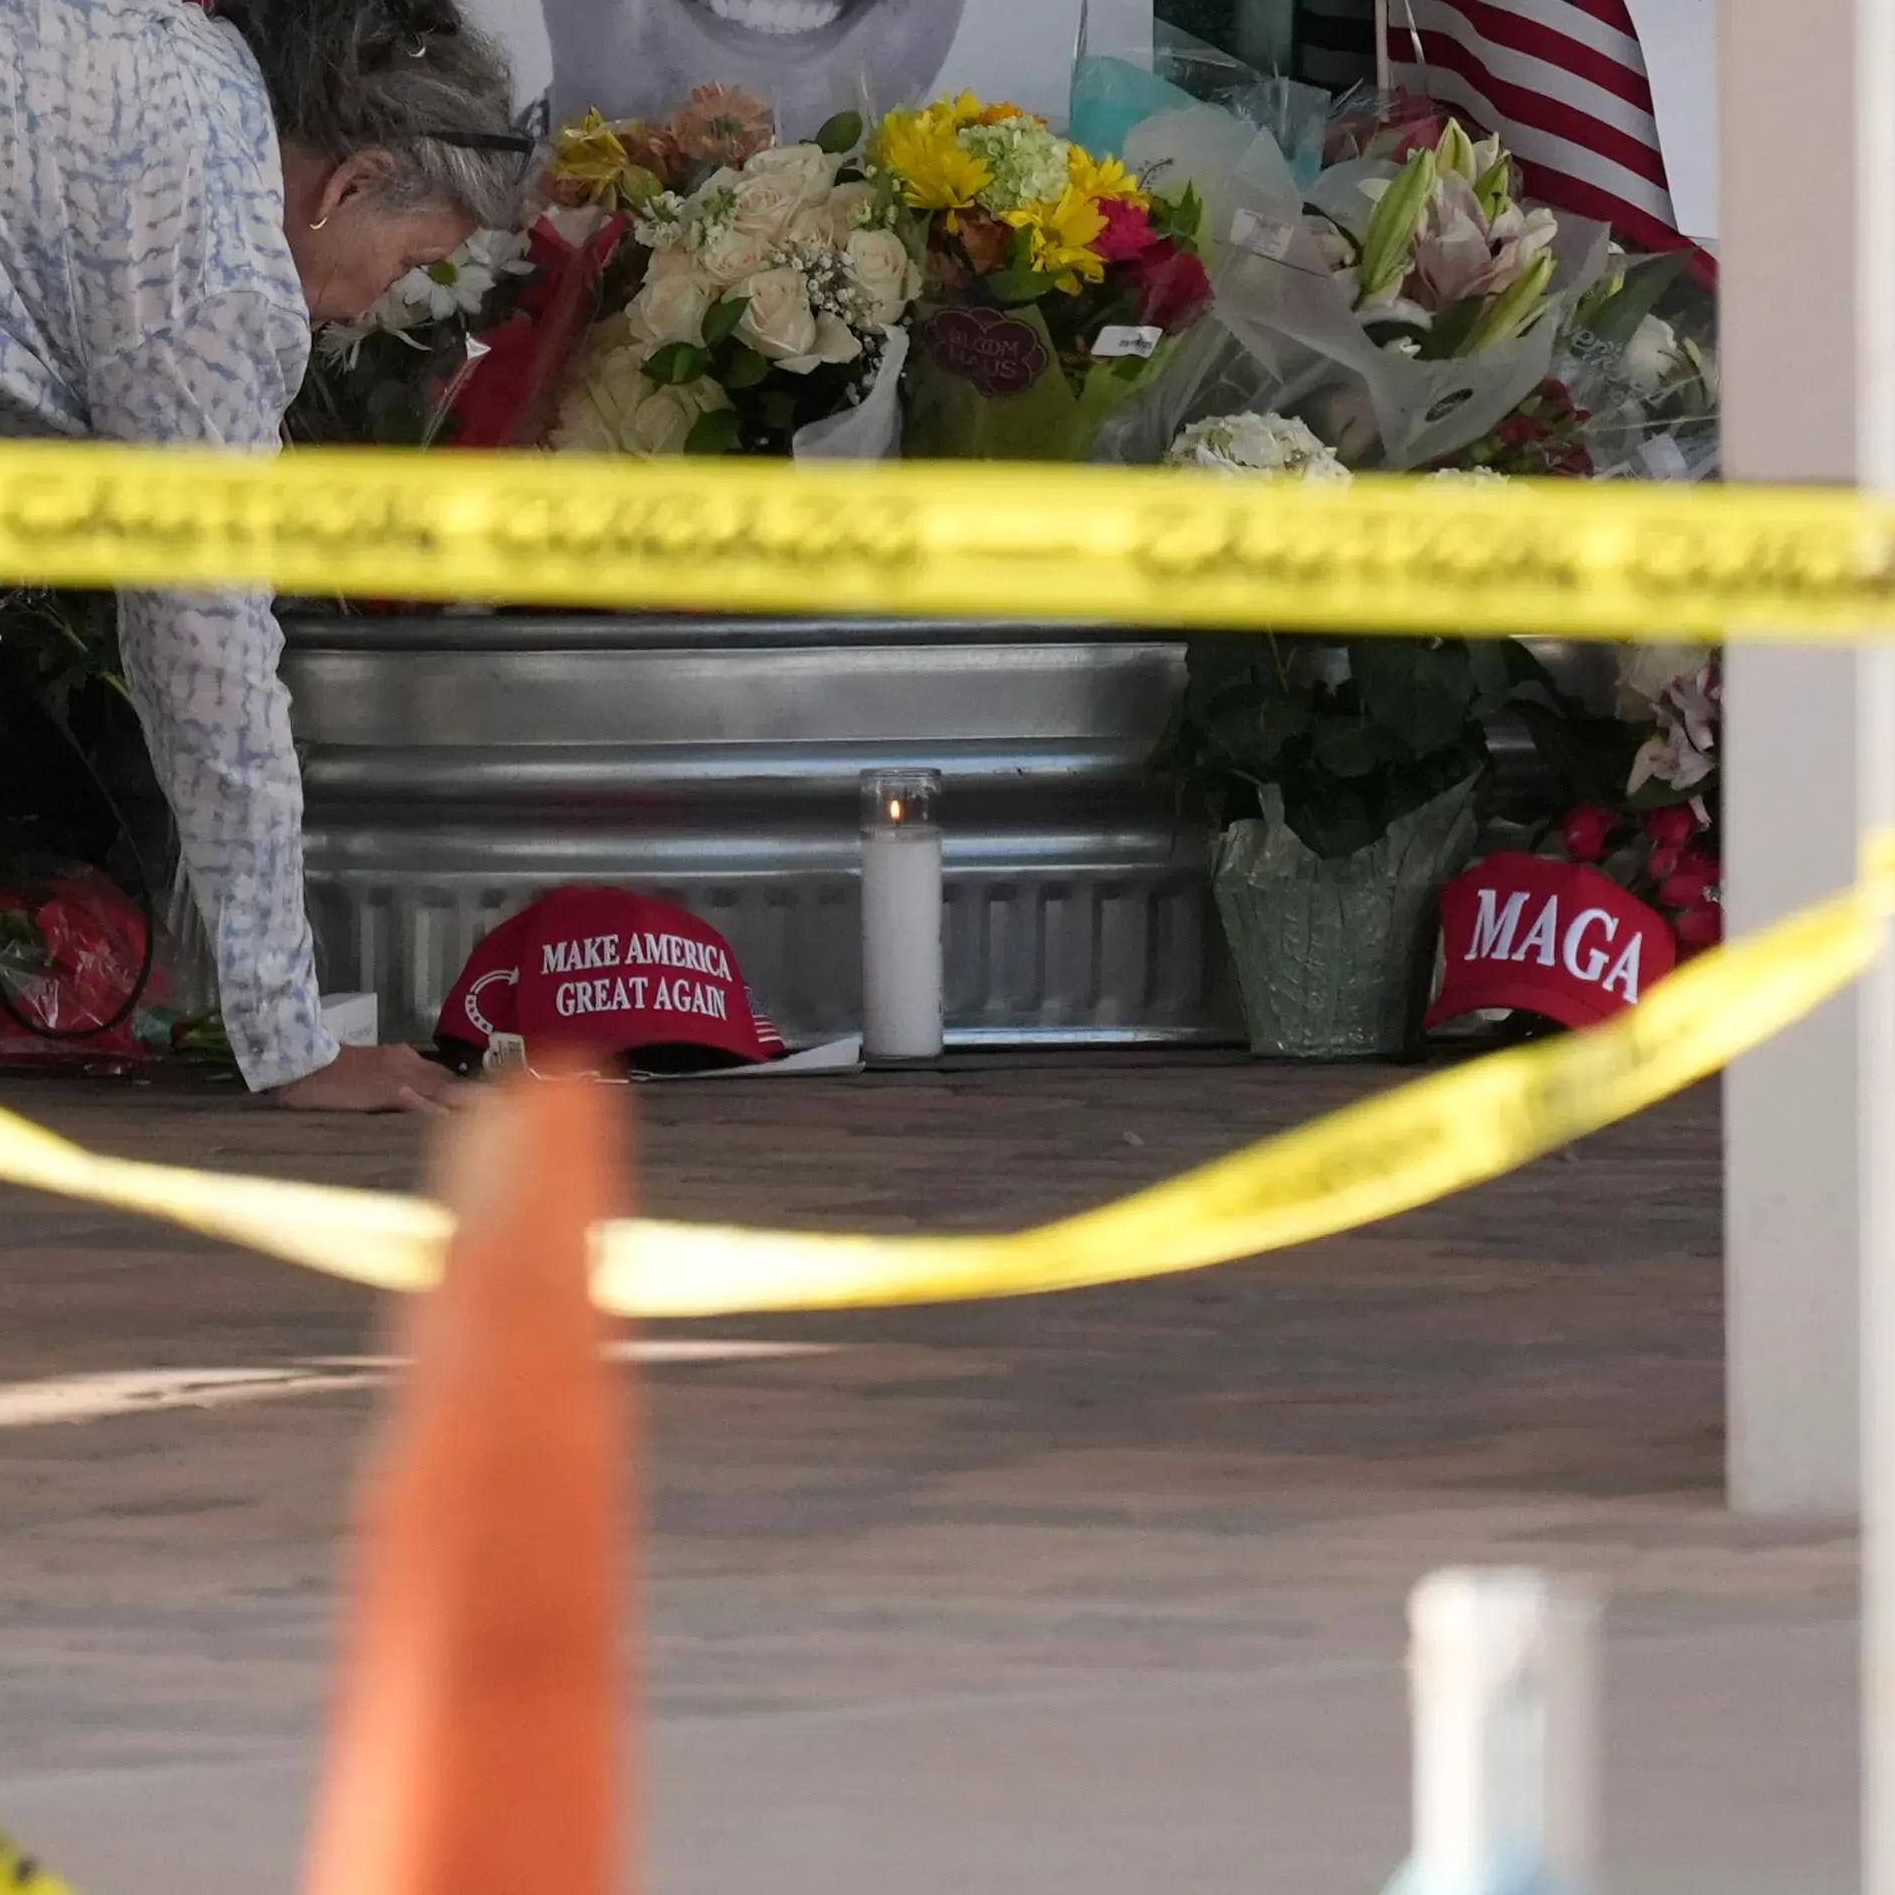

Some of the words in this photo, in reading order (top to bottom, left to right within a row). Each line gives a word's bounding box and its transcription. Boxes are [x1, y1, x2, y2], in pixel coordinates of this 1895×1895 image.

[541, 933, 620, 975] MAKE
[625, 932, 733, 982] AMERICA
[1464, 889, 1643, 1005] MAGA
[556, 976, 649, 1017] GREAT
[654, 977, 728, 1021] AGAIN
